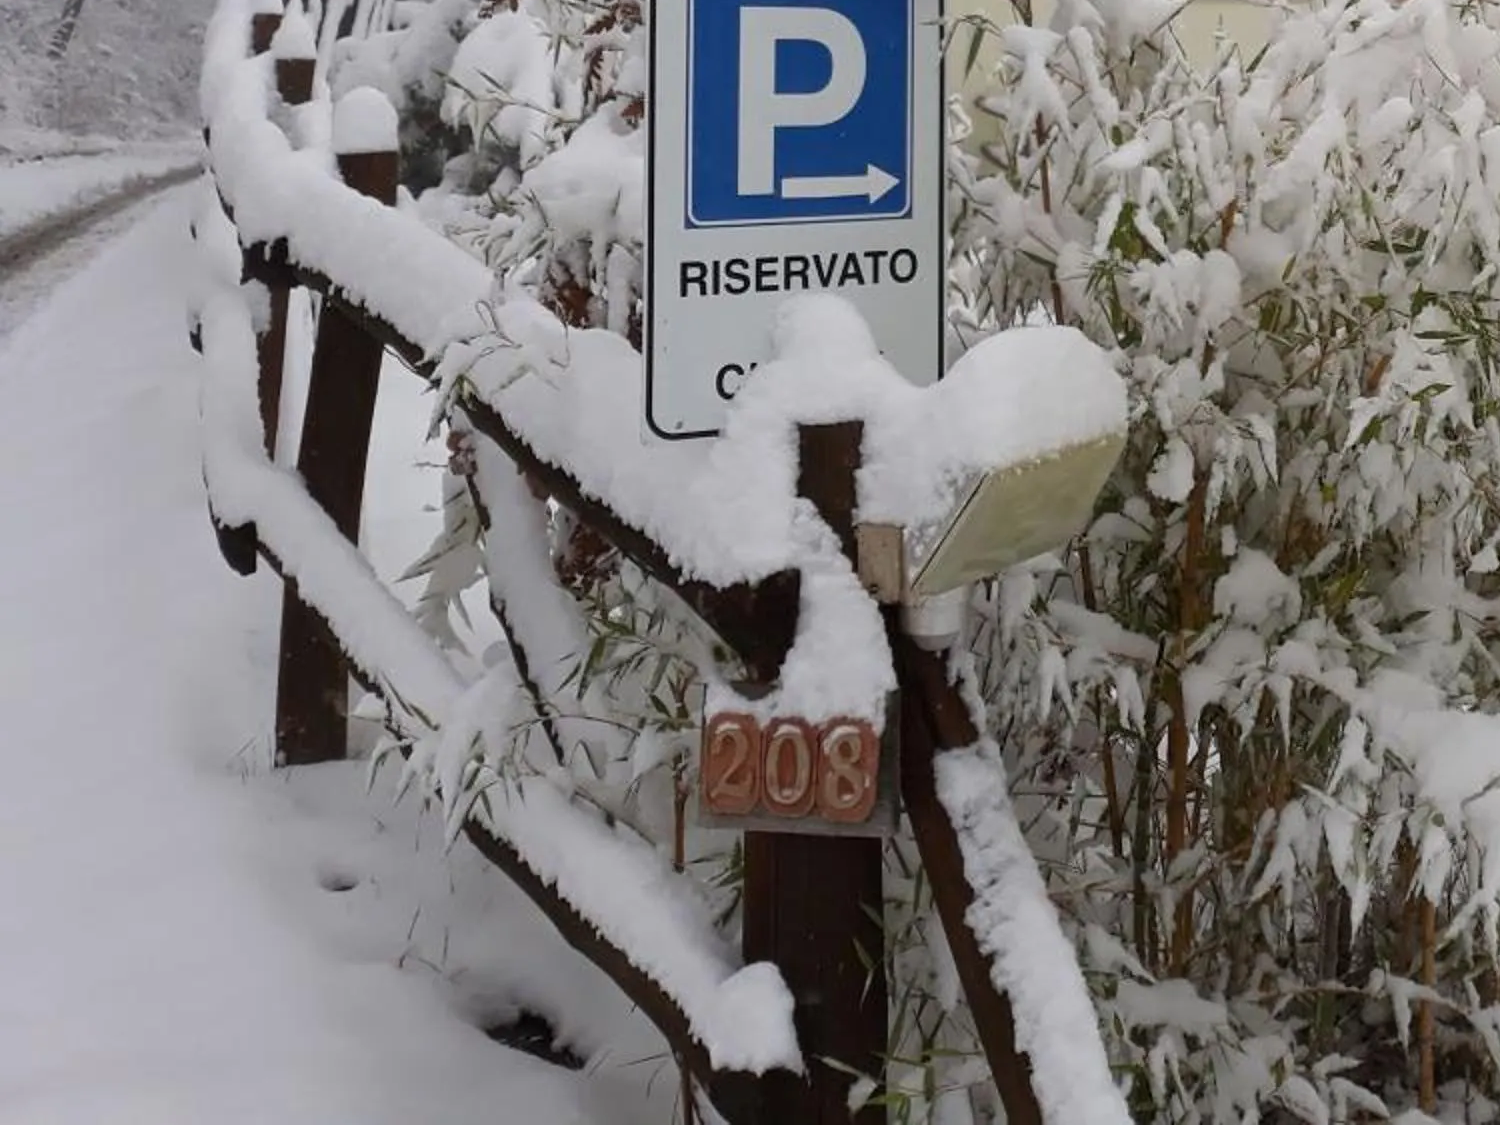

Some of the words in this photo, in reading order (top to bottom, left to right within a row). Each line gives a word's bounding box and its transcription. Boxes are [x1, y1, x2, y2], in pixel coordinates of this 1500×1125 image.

[737, 6, 868, 196] P
[679, 248, 919, 298] RISERVATO
[709, 722, 872, 810] 208
